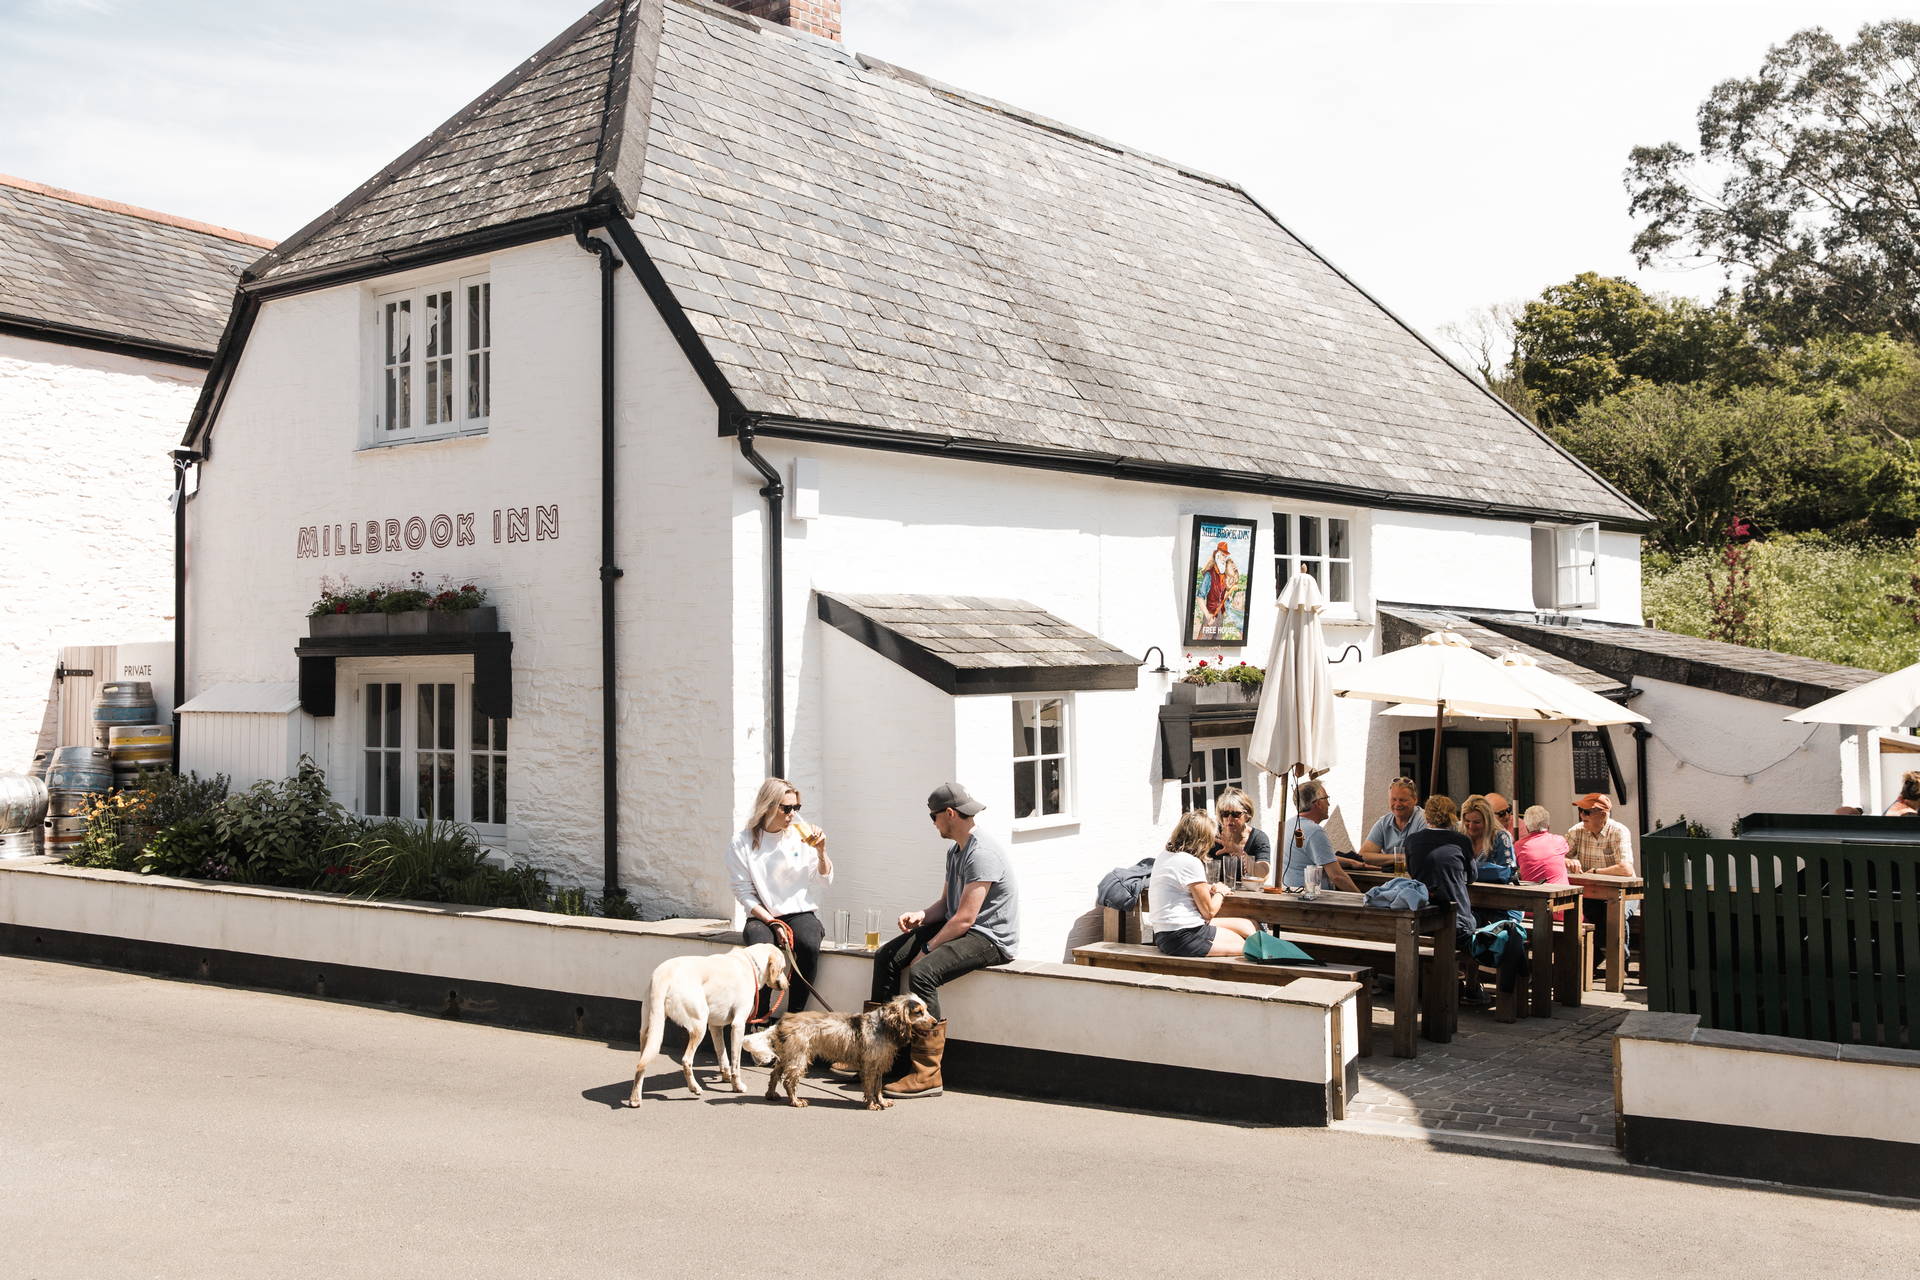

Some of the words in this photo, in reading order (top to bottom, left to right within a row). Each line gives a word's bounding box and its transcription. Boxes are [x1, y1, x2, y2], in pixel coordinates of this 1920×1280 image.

[296, 512, 476, 558] MILLBROOK
[493, 504, 559, 543] INN
[1201, 526, 1237, 540] MILLBROOK
[1237, 529, 1251, 540] INN
[1202, 626, 1217, 634] FREE
[1217, 626, 1236, 634] HOUSE
[123, 664, 152, 676] PRIVATE
